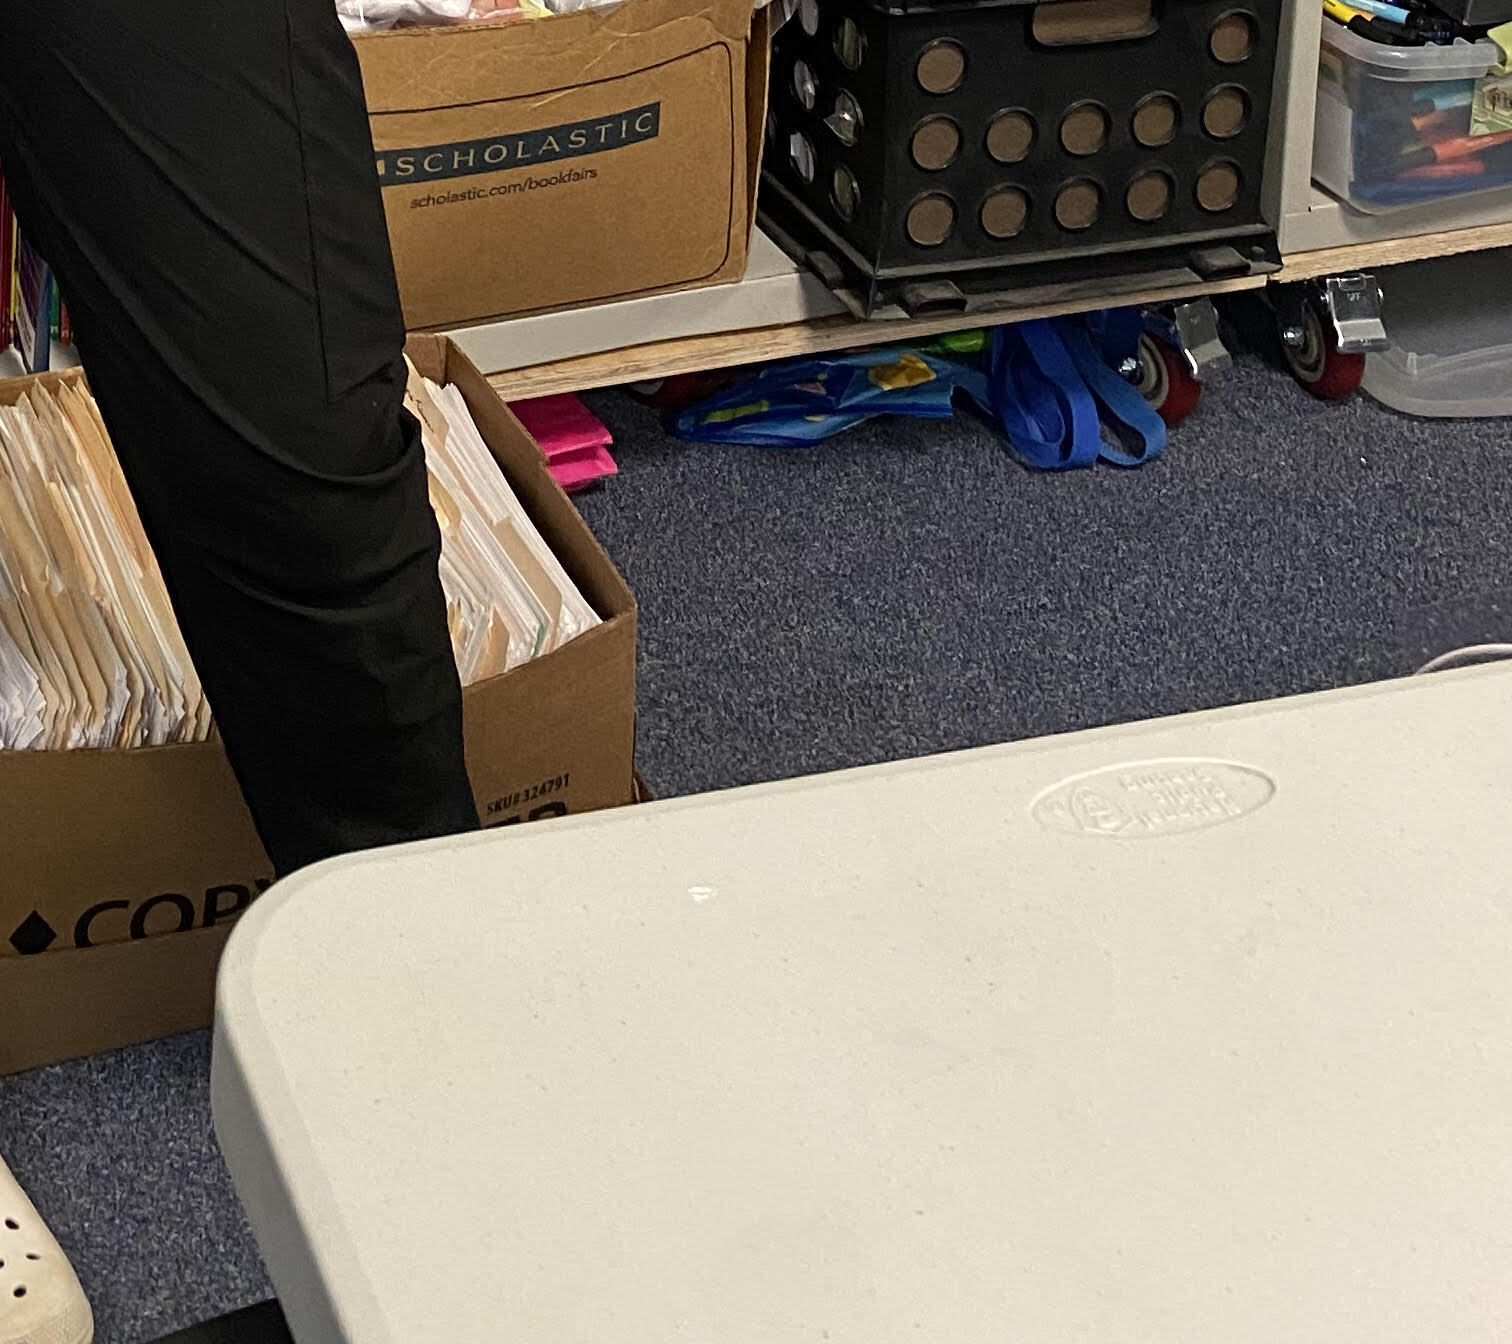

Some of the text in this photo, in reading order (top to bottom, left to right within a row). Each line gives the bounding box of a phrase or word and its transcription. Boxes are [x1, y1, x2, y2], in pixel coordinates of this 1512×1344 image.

[395, 112, 653, 177] SCHOLASTIC
[409, 166, 597, 209] scholastic.com/bookfairs
[522, 774, 571, 802] 324791
[73, 877, 279, 949] COP
